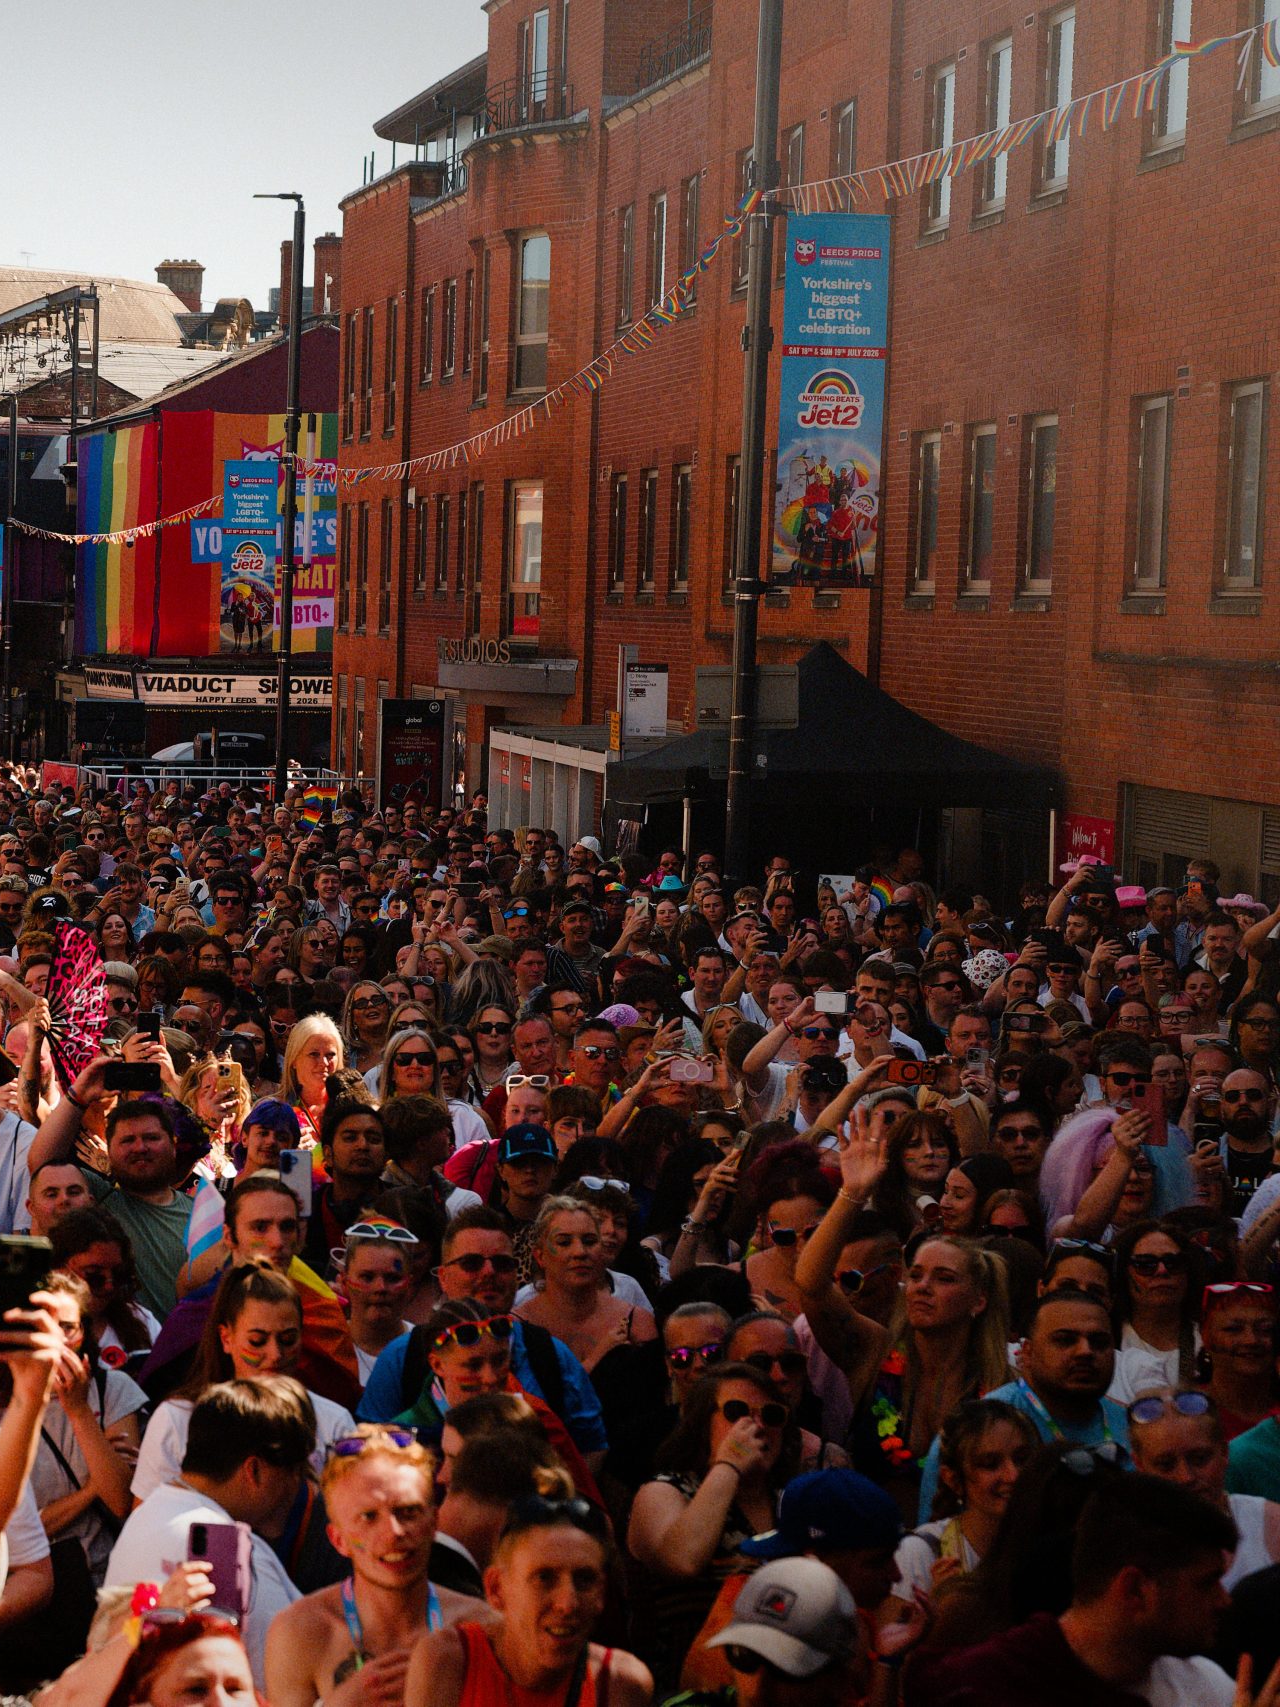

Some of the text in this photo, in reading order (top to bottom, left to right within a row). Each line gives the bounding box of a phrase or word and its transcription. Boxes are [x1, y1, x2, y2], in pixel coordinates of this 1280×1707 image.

[822, 249, 879, 258] LEEDS PRIDE
[802, 277, 872, 290] Yorkshire's
[812, 292, 860, 306] biggest
[808, 308, 862, 321] LGBTQ+
[799, 322, 870, 335] celebration
[801, 404, 859, 425] Jet2
[233, 559, 264, 570] Jet2
[142, 676, 236, 693] VIADUCT
[405, 716, 422, 724] global
